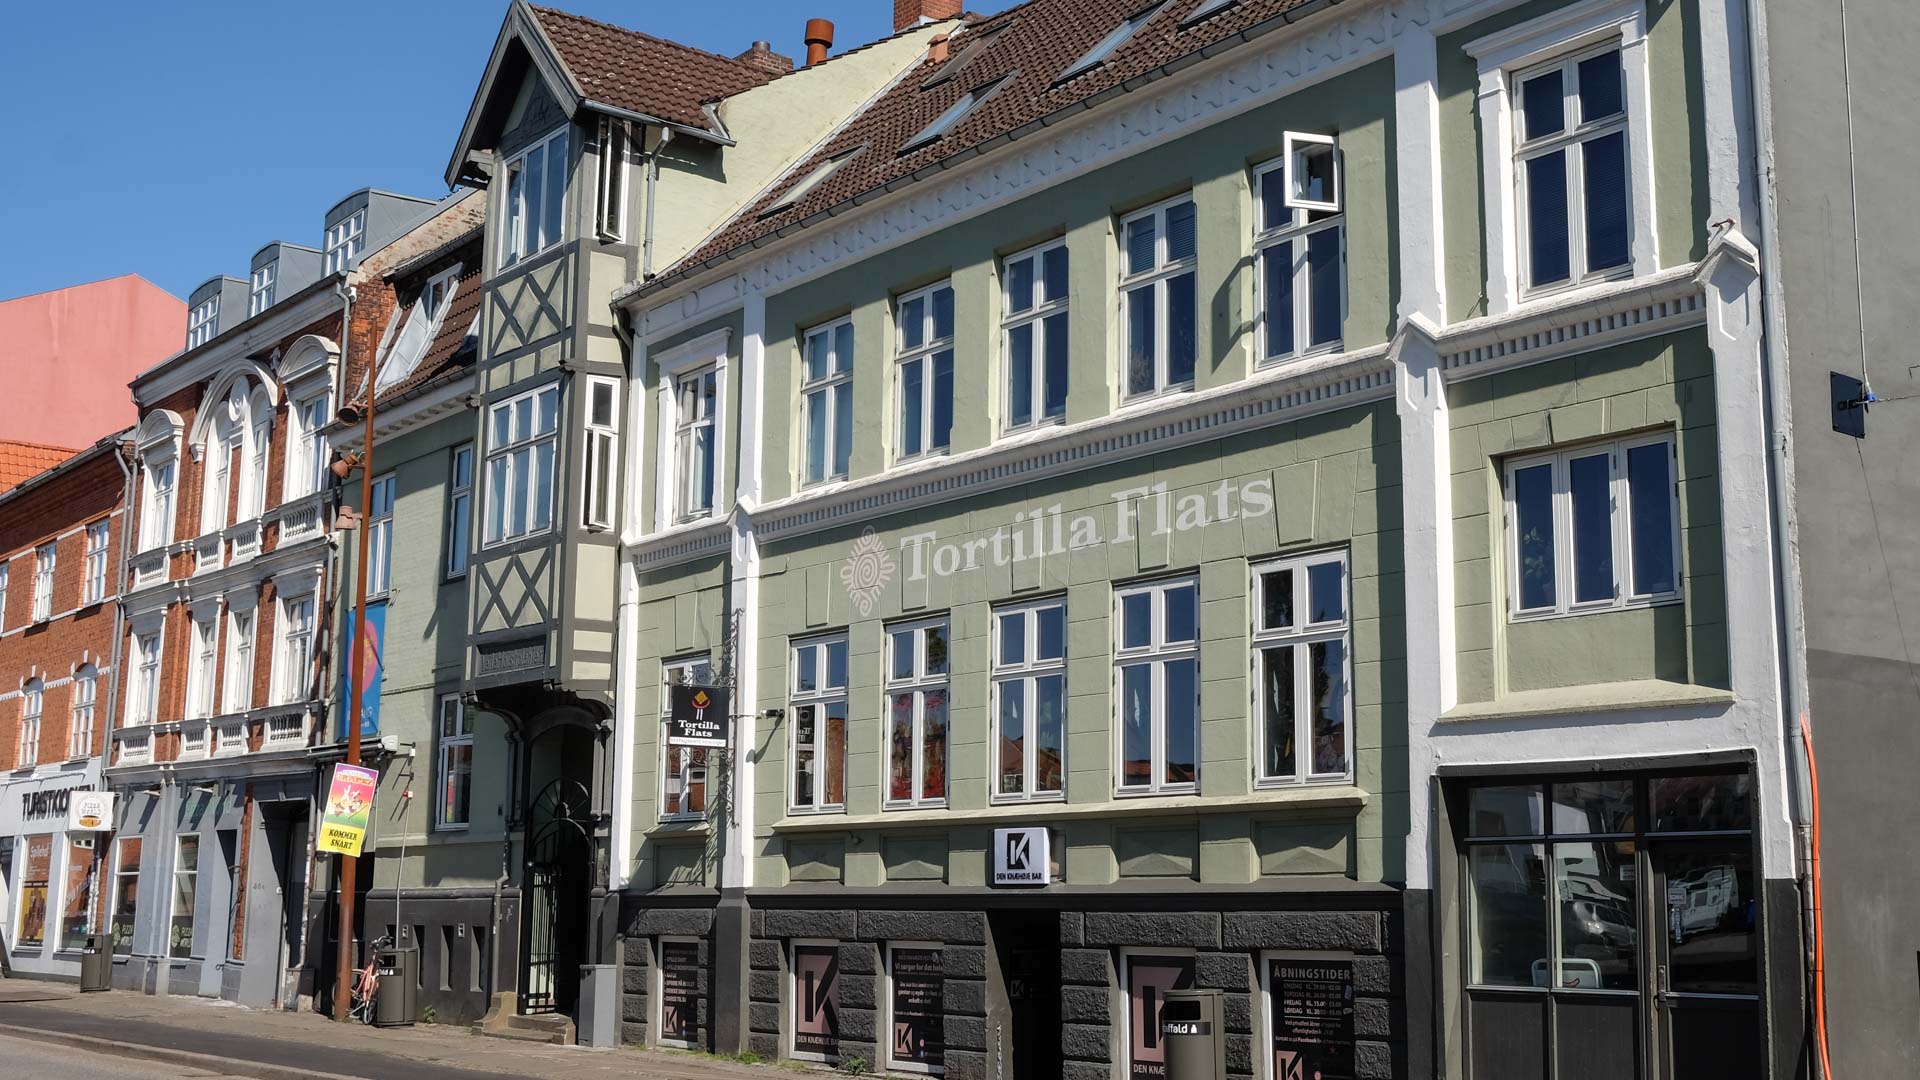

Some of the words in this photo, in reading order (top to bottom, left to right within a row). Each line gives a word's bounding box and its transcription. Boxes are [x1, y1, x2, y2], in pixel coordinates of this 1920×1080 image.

[900, 503, 1102, 581] Tortilla
[1111, 478, 1273, 545] Flats
[678, 720, 720, 729] Tortilla
[684, 729, 713, 737] Flats
[22, 784, 95, 820] TURISTKIO
[329, 829, 358, 841] KOMMER
[330, 839, 353, 849] SNART
[1007, 832, 1030, 870] K
[1032, 873, 1042, 881] BAR
[1274, 964, 1351, 980] ÅBNINGSTIDER
[1134, 1064, 1147, 1073] DEN
